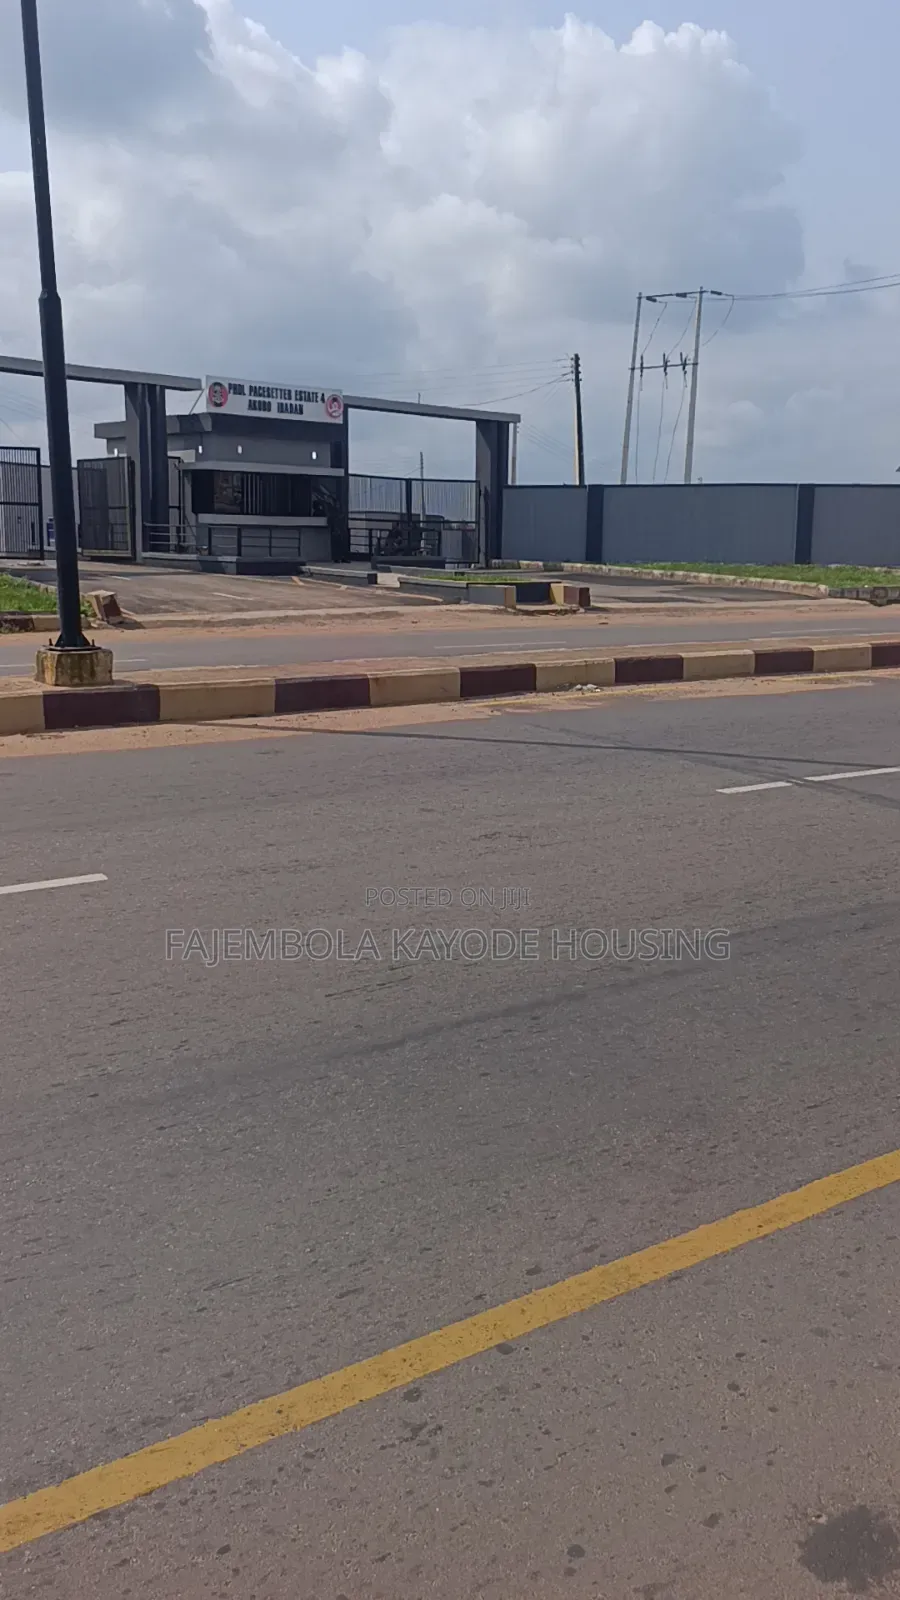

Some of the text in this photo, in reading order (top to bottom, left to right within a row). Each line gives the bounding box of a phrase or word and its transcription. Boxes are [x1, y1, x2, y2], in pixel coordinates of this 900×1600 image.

[248, 385, 292, 401] PACESETTER
[294, 389, 319, 403] ESTATE
[320, 392, 326, 404] 4
[248, 399, 303, 415] AKOBO IBADAN
